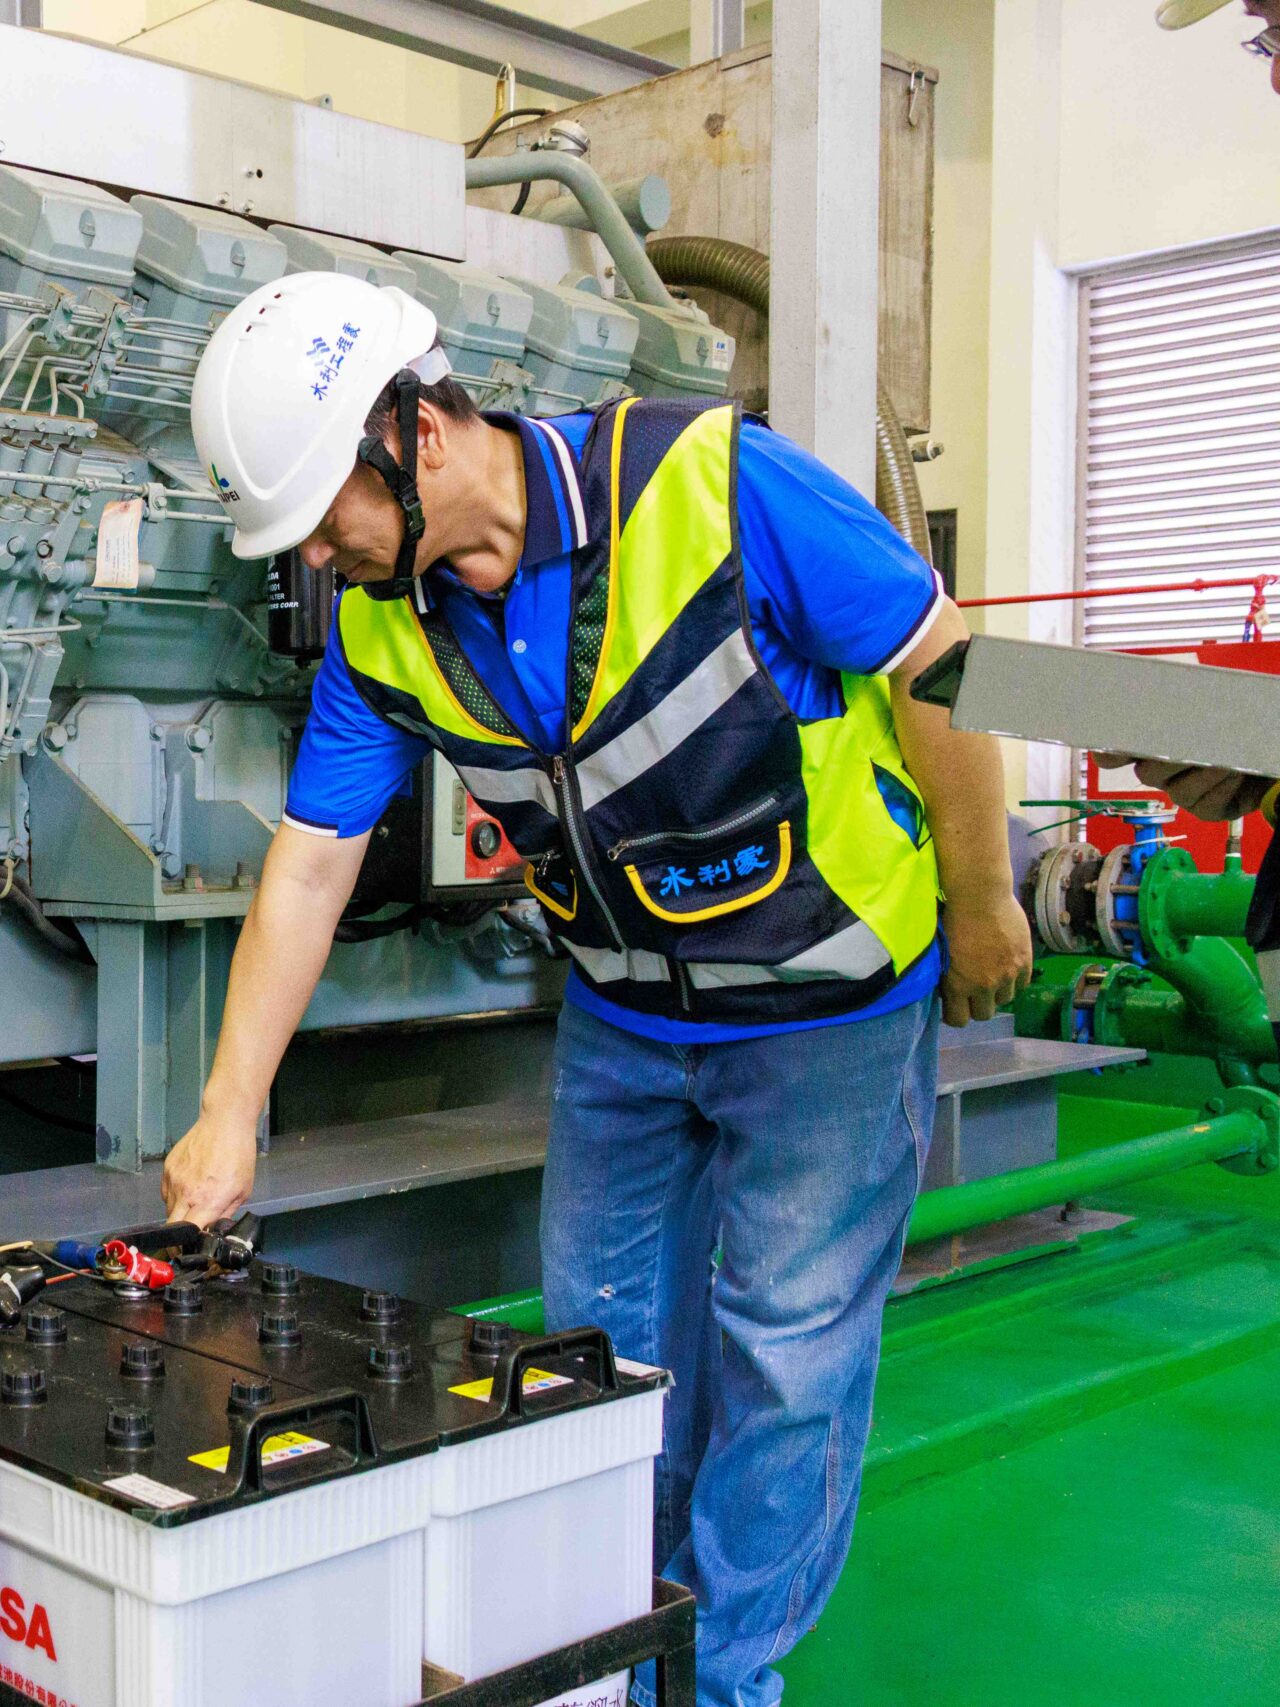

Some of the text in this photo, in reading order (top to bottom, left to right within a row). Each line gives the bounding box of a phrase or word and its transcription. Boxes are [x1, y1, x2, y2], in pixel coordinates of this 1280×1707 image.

[310, 322, 361, 401] 水利工程處
[660, 845, 771, 897] 水利處
